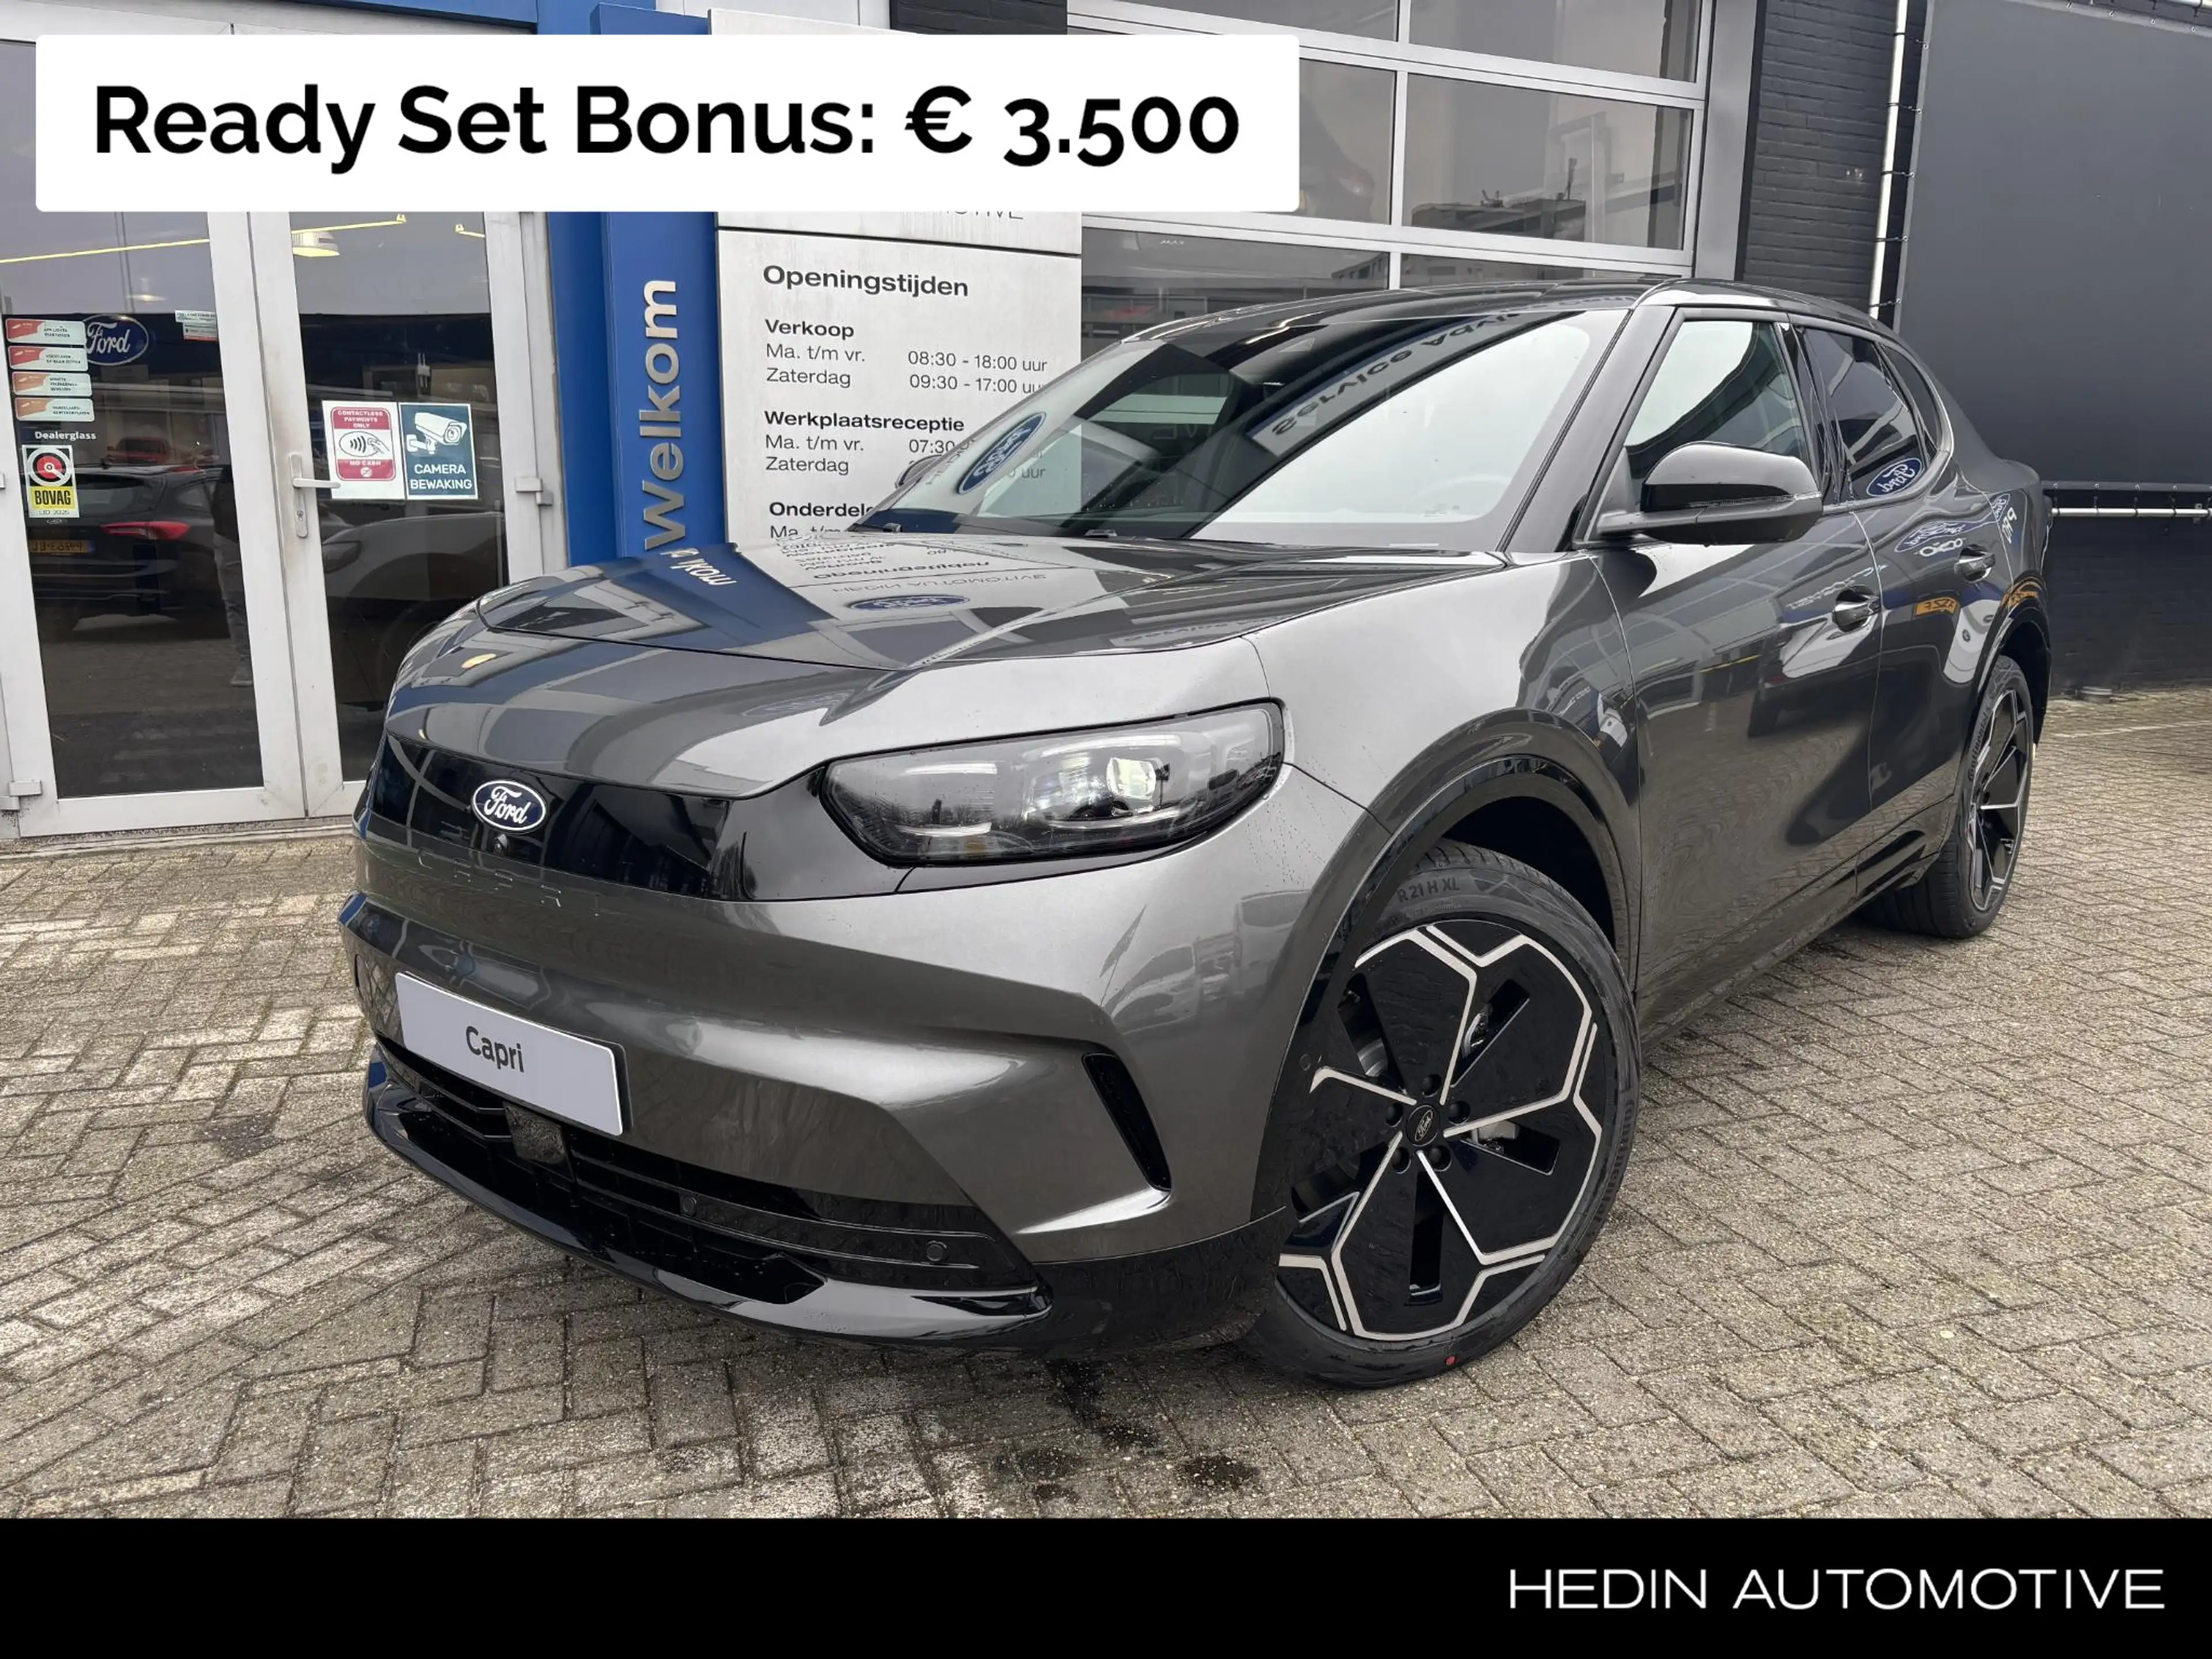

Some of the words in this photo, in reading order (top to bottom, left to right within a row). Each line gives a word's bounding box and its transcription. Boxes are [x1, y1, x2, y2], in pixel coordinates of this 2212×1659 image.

[763, 265, 968, 298] Openingstijden
[85, 323, 131, 355] Ford
[766, 319, 854, 341] Verkoop
[767, 343, 800, 361] Ma.
[807, 346, 838, 361] t/m
[844, 350, 865, 362] vr.
[908, 350, 956, 367] 08:30
[974, 354, 1017, 370] 18:00
[1022, 360, 1048, 372] uur
[766, 367, 851, 389] Zaterdag
[910, 374, 958, 390] 09:30
[975, 377, 1017, 393] 17:00
[639, 280, 686, 551] Welkom
[764, 411, 964, 434] Werkplaatsreceptie
[35, 430, 96, 441] Dealerglass
[766, 434, 800, 450] Ma.
[806, 435, 837, 450] t/m
[843, 440, 864, 451] vr.
[909, 439, 955, 454] 07:30
[414, 464, 467, 474] CAMERA
[766, 456, 849, 476] Zaterdag
[410, 479, 473, 490] BEWAKING
[34, 490, 71, 505] BOVAG
[484, 786, 531, 824] Ford
[1409, 883, 1425, 898] 21
[1426, 880, 1439, 894] H
[1442, 877, 1461, 892] XL
[465, 1025, 525, 1073] Capri
